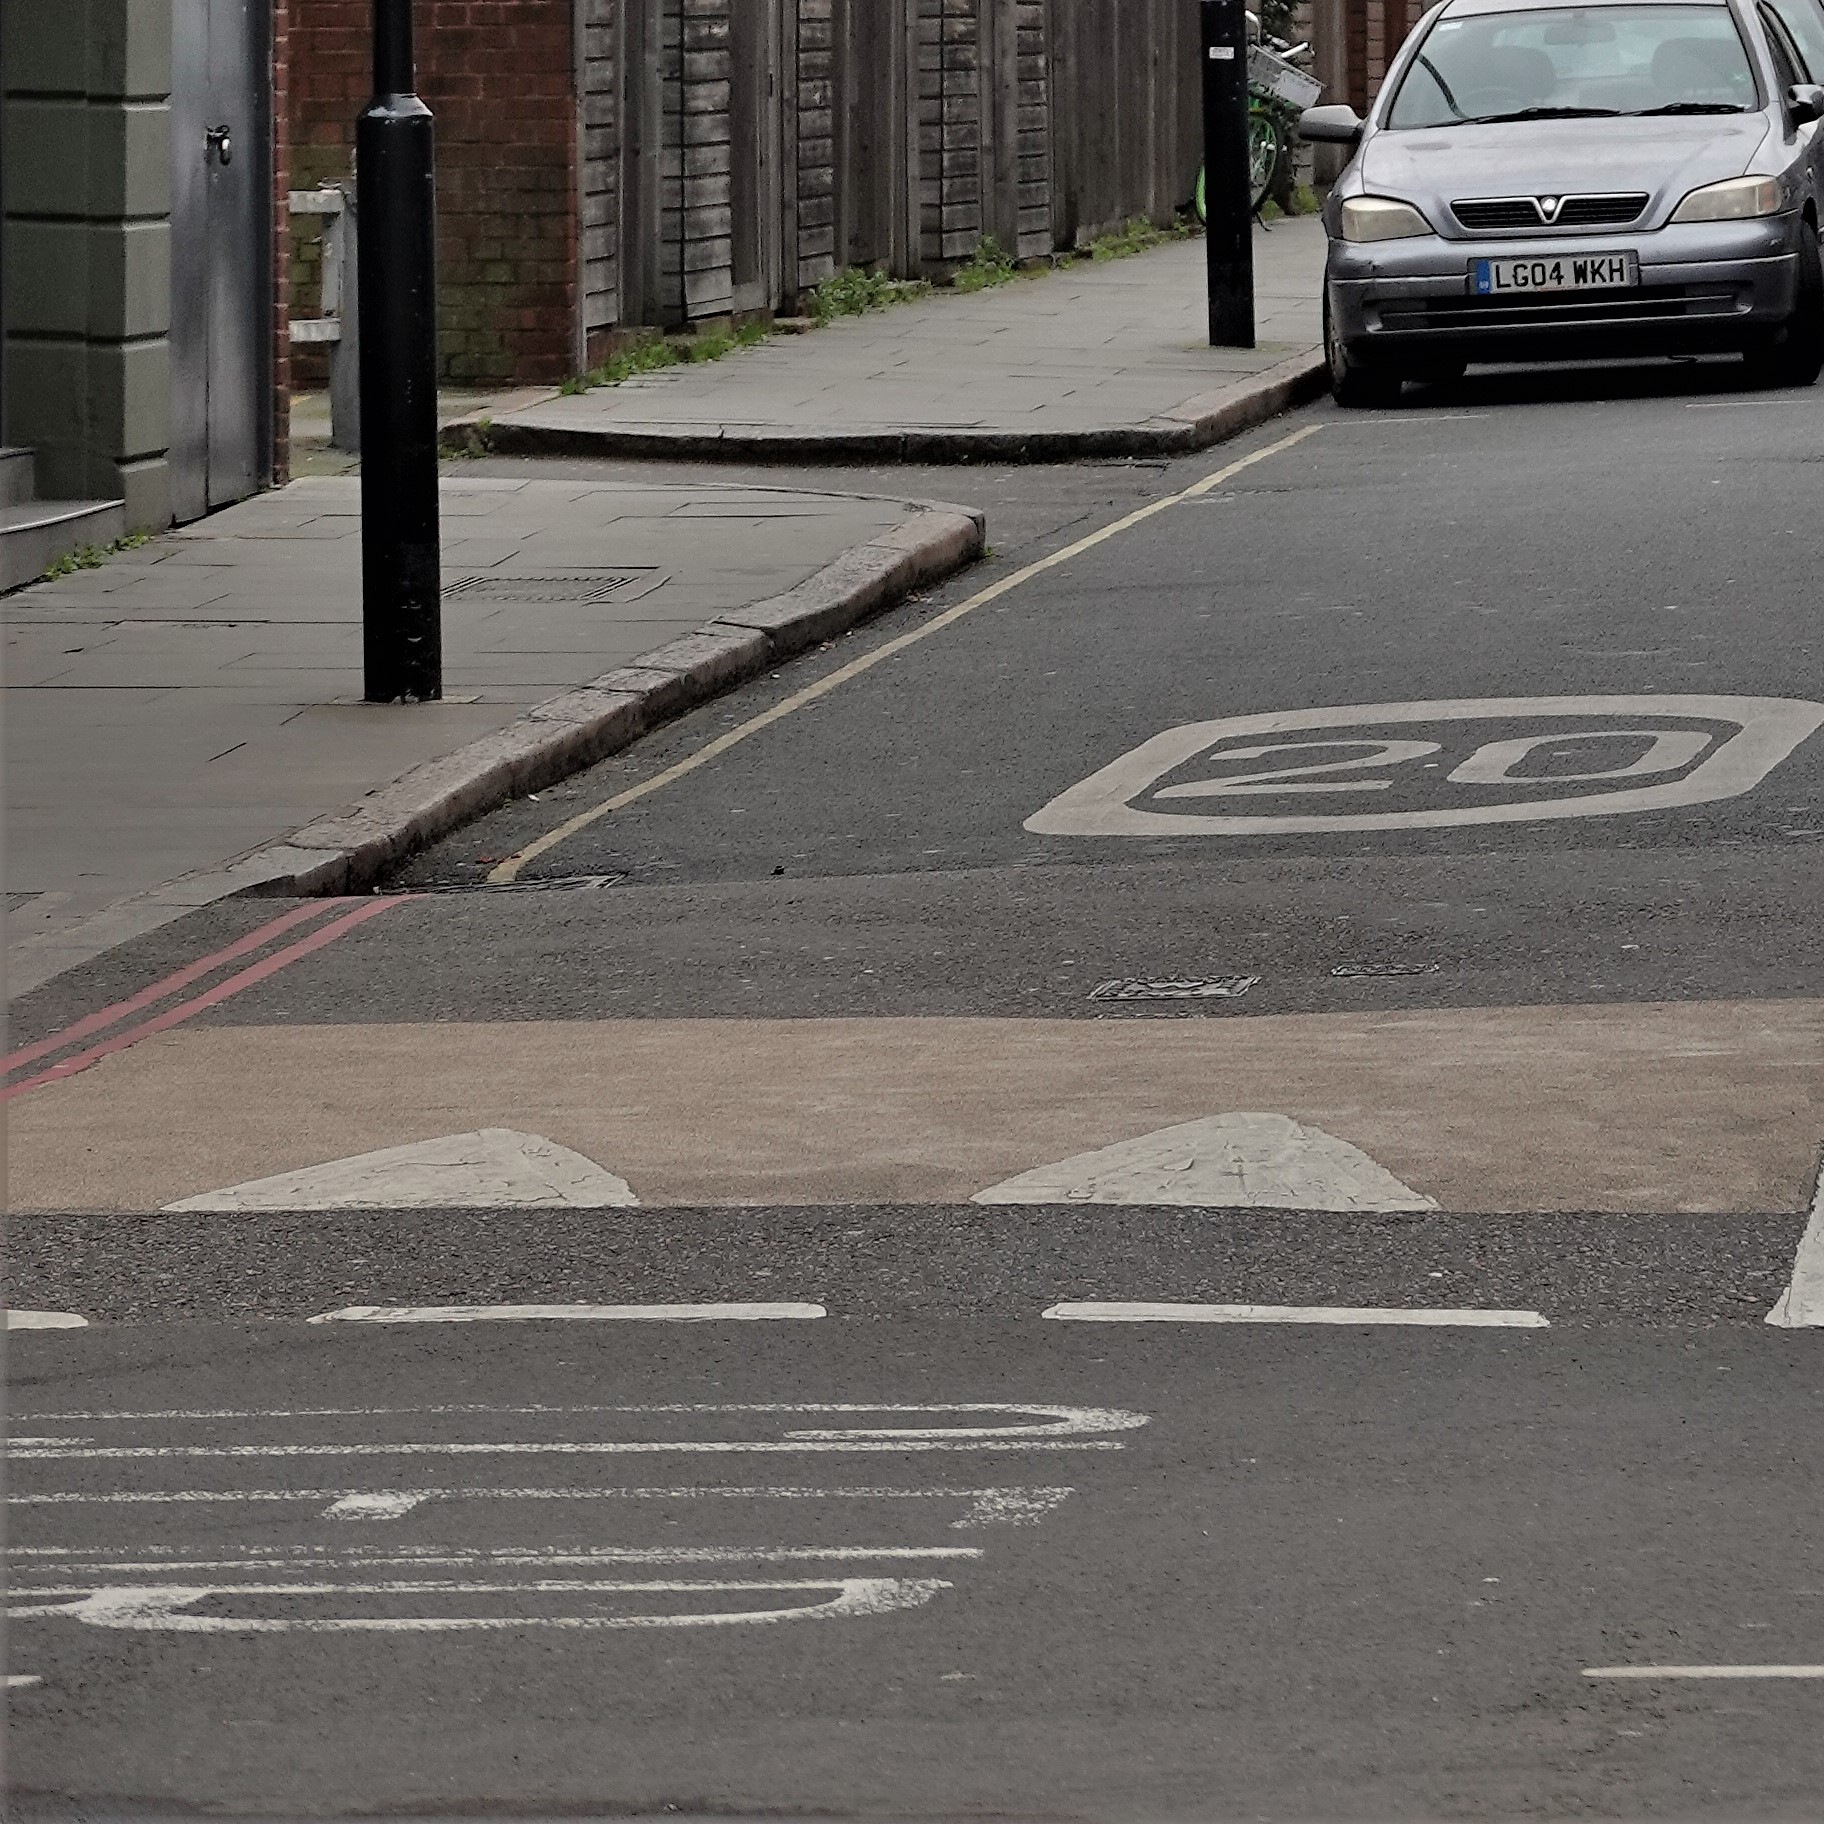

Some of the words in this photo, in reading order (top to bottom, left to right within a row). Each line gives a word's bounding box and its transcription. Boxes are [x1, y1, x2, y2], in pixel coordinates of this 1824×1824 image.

[1495, 261, 1565, 289] LG04
[1573, 258, 1625, 285] WKH
[1150, 729, 1714, 800] 20
